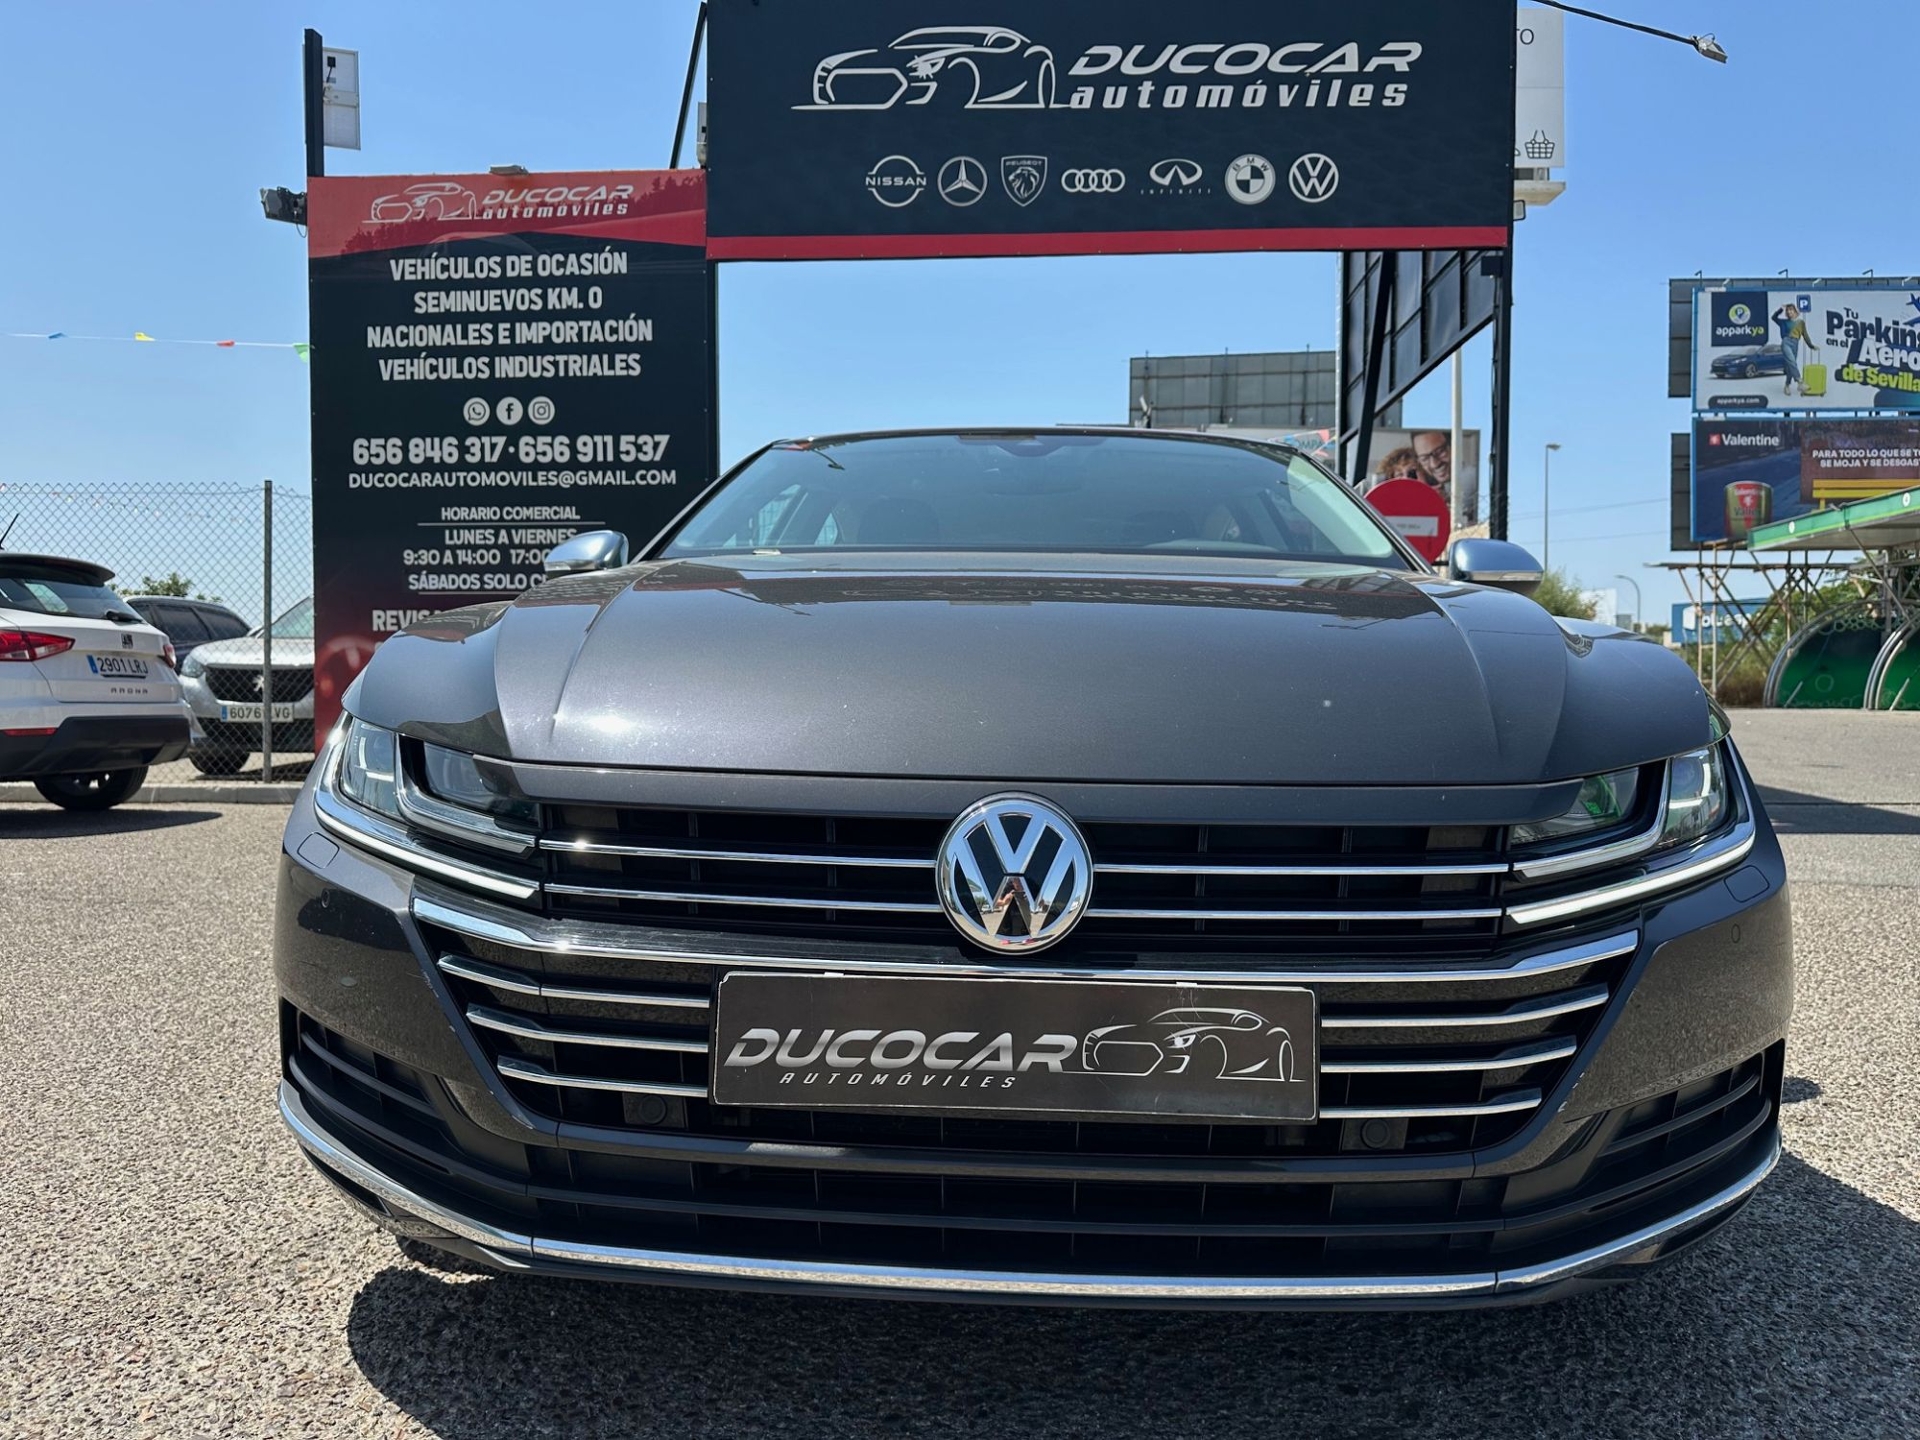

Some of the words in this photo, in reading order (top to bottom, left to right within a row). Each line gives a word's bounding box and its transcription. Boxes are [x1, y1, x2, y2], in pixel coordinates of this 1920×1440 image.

[1517, 28, 1534, 45] O
[1067, 41, 1423, 76] DUCOCAR
[1069, 78, 1408, 109] automóviles
[865, 176, 927, 186] NISSAN
[482, 184, 634, 205] DUCOCAR
[482, 201, 629, 220] automóviles
[390, 252, 501, 281] VEHÍCULOS
[505, 254, 533, 278] DE
[537, 246, 628, 277] OCASIÓN
[413, 288, 542, 314] SEMINUEVOS
[547, 287, 584, 310] KM.
[1843, 306, 1859, 320] Tu
[367, 323, 494, 348] NACIONALES
[498, 322, 511, 345] E
[515, 313, 653, 345] IMPORTACIÓN
[1715, 325, 1764, 337] apparkya
[1826, 310, 1920, 348] Parkin
[378, 352, 491, 381] VEHÍCULOS
[494, 353, 642, 379] INDUSTRIALES
[1842, 363, 1864, 382] de
[1721, 433, 1780, 446] Valentine
[352, 437, 403, 466] 656
[408, 436, 459, 465] 846
[576, 434, 614, 463] 911
[619, 434, 671, 463] 537
[1812, 449, 1838, 458] PARA
[1838, 449, 1866, 458] TODO
[1866, 449, 1879, 458] LO
[1879, 449, 1899, 459] QUE
[1900, 449, 1911, 458] SE
[1820, 459, 1832, 468] SE
[1833, 459, 1861, 468] MOJA
[1862, 459, 1869, 467] Y
[1869, 459, 1882, 467] SE
[1883, 458, 1920, 467] DESGAS
[348, 470, 677, 489] DUCOCARAUTOMOVILES@GMAIL.COM
[441, 506, 500, 521] HORARIO
[502, 506, 581, 521] COMERCIAL
[444, 528, 496, 545] LUNES
[498, 529, 510, 545] A
[403, 549, 441, 566] 9:30
[442, 550, 454, 565] A
[456, 549, 501, 565] 14:00
[408, 570, 481, 590] SÁBADOS
[483, 573, 528, 590] SOLO
[97, 656, 127, 673] 2901
[229, 706, 262, 720] 6076
[722, 1028, 1079, 1074] DUCOCAR
[779, 1071, 1018, 1090] AUTOMÓVILES
